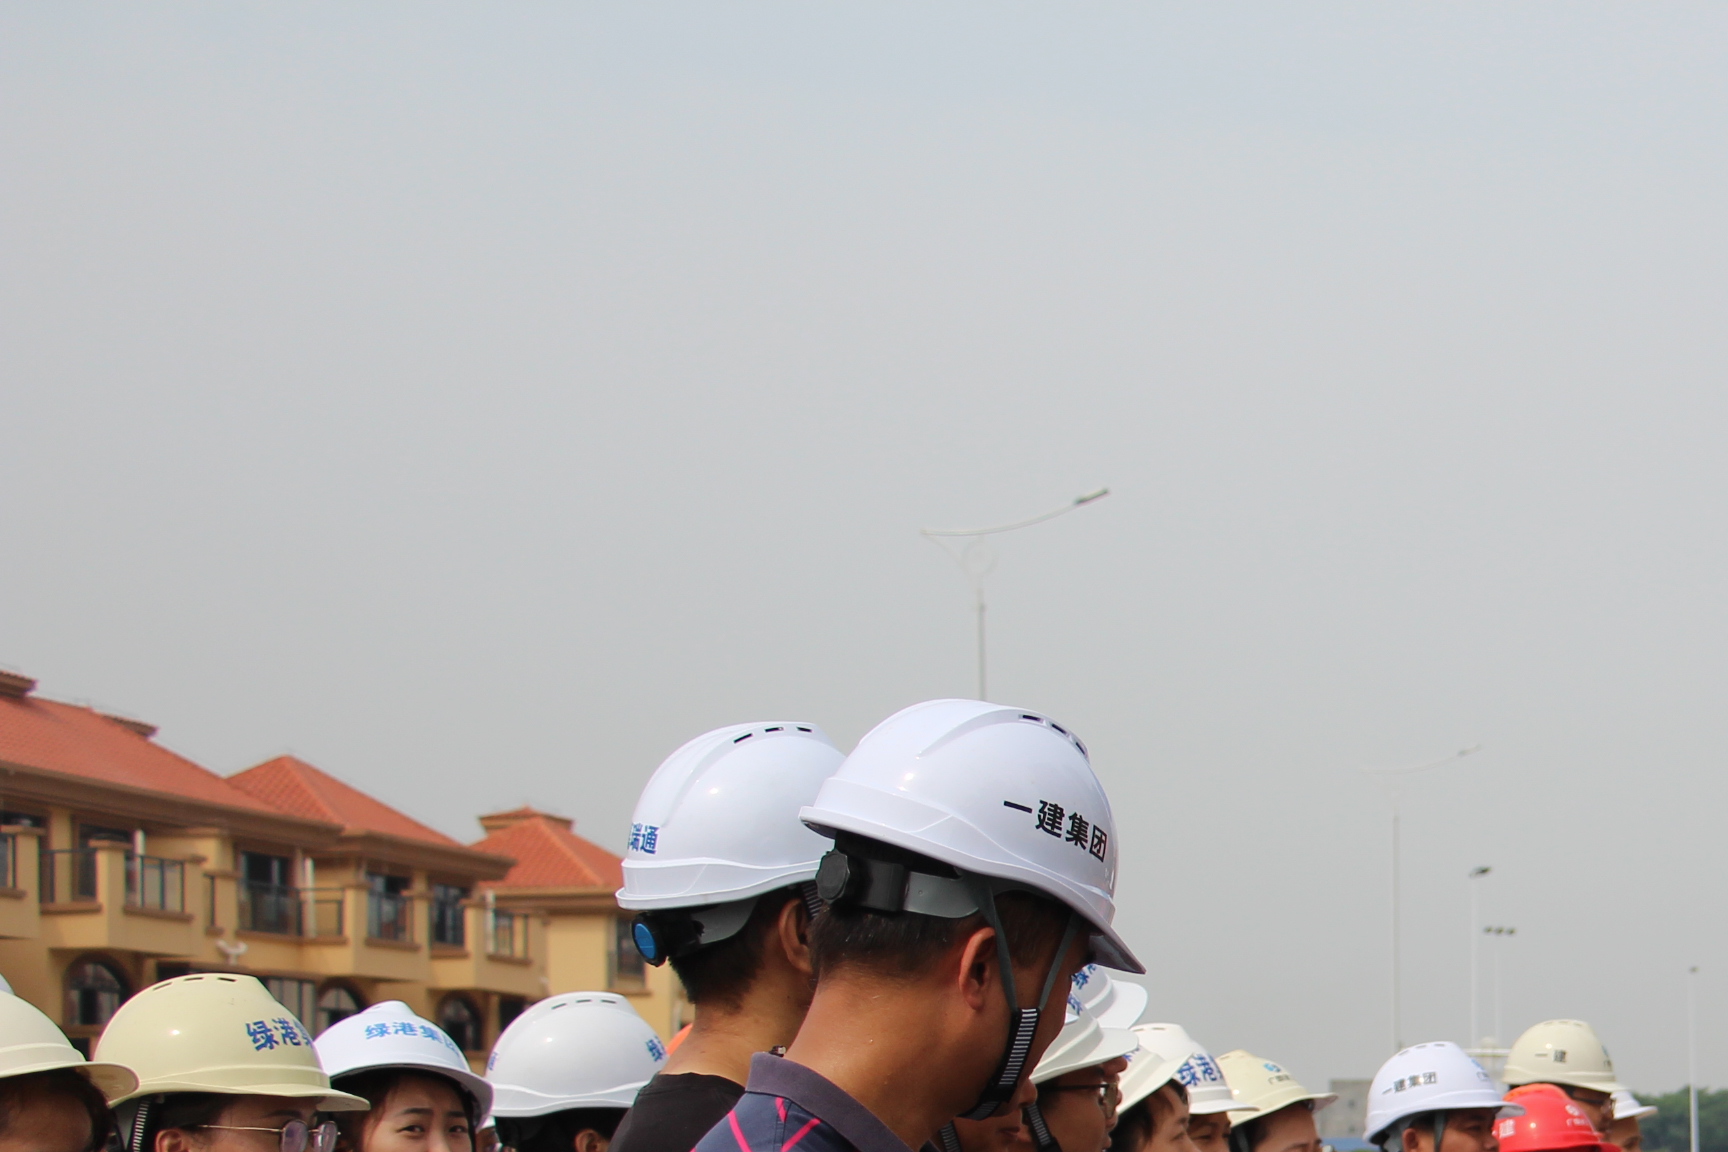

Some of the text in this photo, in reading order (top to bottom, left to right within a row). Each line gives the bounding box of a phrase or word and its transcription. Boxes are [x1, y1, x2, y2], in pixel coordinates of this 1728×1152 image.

[1003, 799, 1108, 863] 一建集团
[1382, 1071, 1438, 1095] 一建集团
